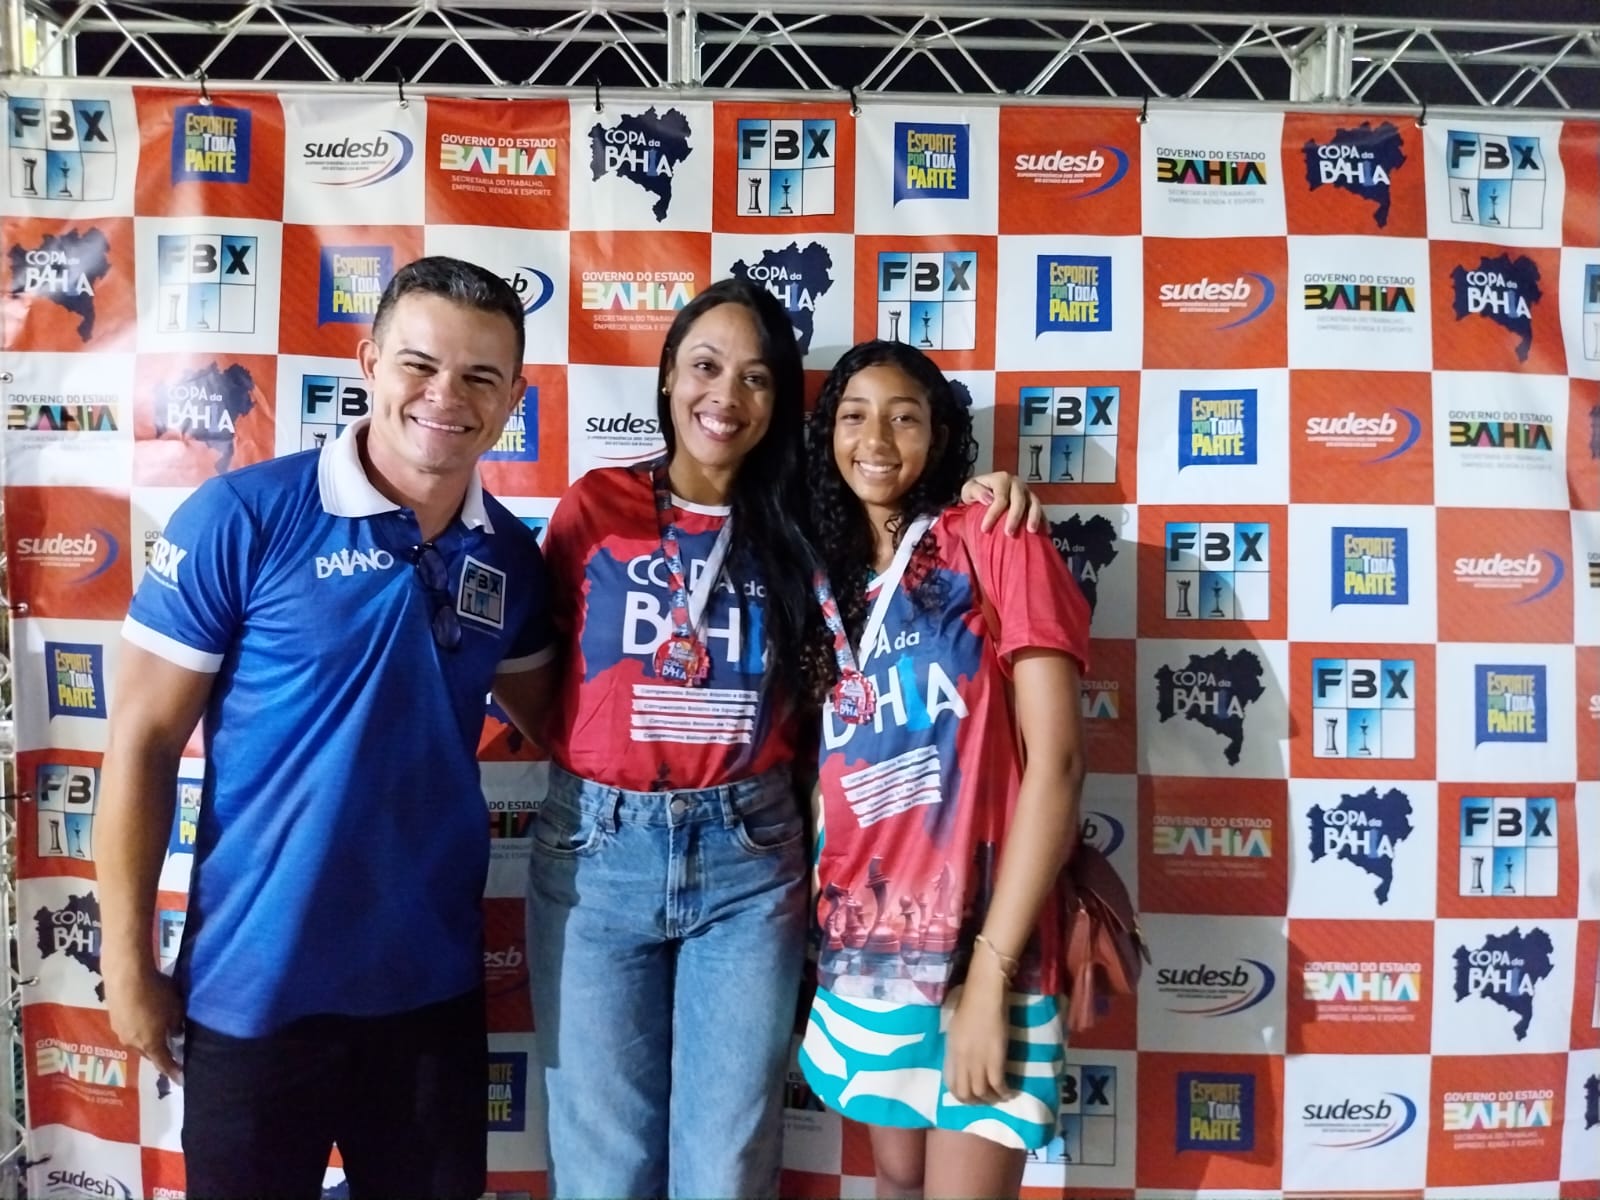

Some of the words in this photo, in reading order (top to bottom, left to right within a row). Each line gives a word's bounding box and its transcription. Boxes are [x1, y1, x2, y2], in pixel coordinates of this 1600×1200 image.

[11, 107, 108, 142] FBX
[185, 113, 237, 136] ESPORTE
[202, 133, 236, 153] TODA
[303, 136, 389, 158] sudesb
[441, 133, 495, 146] GOVERNO
[498, 138, 514, 147] DO
[516, 138, 556, 148] ESTADO
[605, 129, 646, 145] COPA
[648, 138, 660, 147] da
[742, 128, 832, 161] FBX
[907, 129, 956, 154] ESPORTE
[185, 151, 236, 173] PARTE
[605, 142, 673, 178] BAHIA
[907, 153, 925, 166] POR
[924, 151, 956, 169] TODA
[1015, 150, 1104, 171] sudesb
[1156, 147, 1206, 158] GOVERNO
[1209, 150, 1223, 159] DO
[1226, 151, 1265, 160] ESTADO
[1318, 144, 1360, 159] COPA
[1362, 151, 1374, 159] da
[1451, 140, 1540, 170] FBX
[452, 175, 494, 185] SECRETARIA
[907, 166, 956, 190] PARTE
[1319, 160, 1390, 185] BAHIA
[25, 250, 67, 265] COPA
[25, 266, 94, 297] BAHIA
[582, 272, 634, 281] GOVERNO
[636, 272, 651, 281] DO
[654, 272, 695, 281] ESTADO
[747, 265, 787, 281] COPA
[789, 272, 802, 281] da
[882, 260, 972, 292] FBX
[1050, 262, 1098, 286] ESPORTE
[1304, 273, 1356, 283] GOVERNO
[1360, 274, 1374, 283] DO
[1377, 275, 1415, 285] ESTADO
[1466, 271, 1504, 287] COPA
[1506, 281, 1518, 289] da
[1067, 284, 1098, 301] TODA
[1159, 277, 1251, 301] sudesb
[1049, 299, 1098, 322] PARTE
[1467, 287, 1531, 318] BAHIA
[167, 384, 207, 401] COPA
[209, 393, 222, 402] da
[306, 385, 368, 416] FB
[167, 400, 235, 433] BAHIA
[1023, 395, 1114, 426] FBX
[1192, 398, 1244, 420] ESPORTE
[1449, 410, 1500, 420] GOVERNO
[1503, 412, 1517, 421] DO
[1520, 413, 1552, 423] ESTADO
[1209, 417, 1244, 435] TODA
[1306, 412, 1396, 435] sudesb
[1192, 433, 1244, 456] PARTE
[17, 533, 97, 554] sudesb
[1170, 532, 1263, 562] FBX
[1344, 534, 1395, 558] ESPORTE
[315, 548, 394, 579] BAIANO
[1362, 555, 1394, 574] TODA
[1454, 553, 1541, 576] sudesb
[466, 567, 501, 595] FBX
[1344, 571, 1396, 595] PARTE
[894, 628, 920, 650] da
[1172, 672, 1215, 687] COPA
[1218, 680, 1231, 688] da
[1318, 668, 1409, 698] FBX
[1172, 688, 1244, 719] BAHIA
[40, 775, 92, 804] FB
[488, 801, 506, 810] DO
[1323, 809, 1366, 826] COPA
[1368, 818, 1382, 827] da
[1465, 807, 1552, 837] FBX
[1323, 825, 1394, 858] BAHIA
[52, 911, 90, 926] COPA
[1304, 962, 1358, 971] GOVERNO
[1360, 962, 1377, 972] DO
[1379, 962, 1421, 972] ESTADO
[1468, 950, 1510, 966] COPA
[1511, 958, 1523, 966] da
[1156, 964, 1248, 987] sudesb
[1468, 965, 1534, 997] BAHIA
[80, 1044, 93, 1054] DO
[94, 1046, 127, 1060] ESTADO
[1061, 1075, 1110, 1105] BX
[1443, 1092, 1496, 1102] GOVERNO
[1498, 1091, 1513, 1100] DO
[1515, 1090, 1554, 1099] ESTADO
[1302, 1099, 1391, 1120] sudesb
[47, 1169, 114, 1197] sudesb
